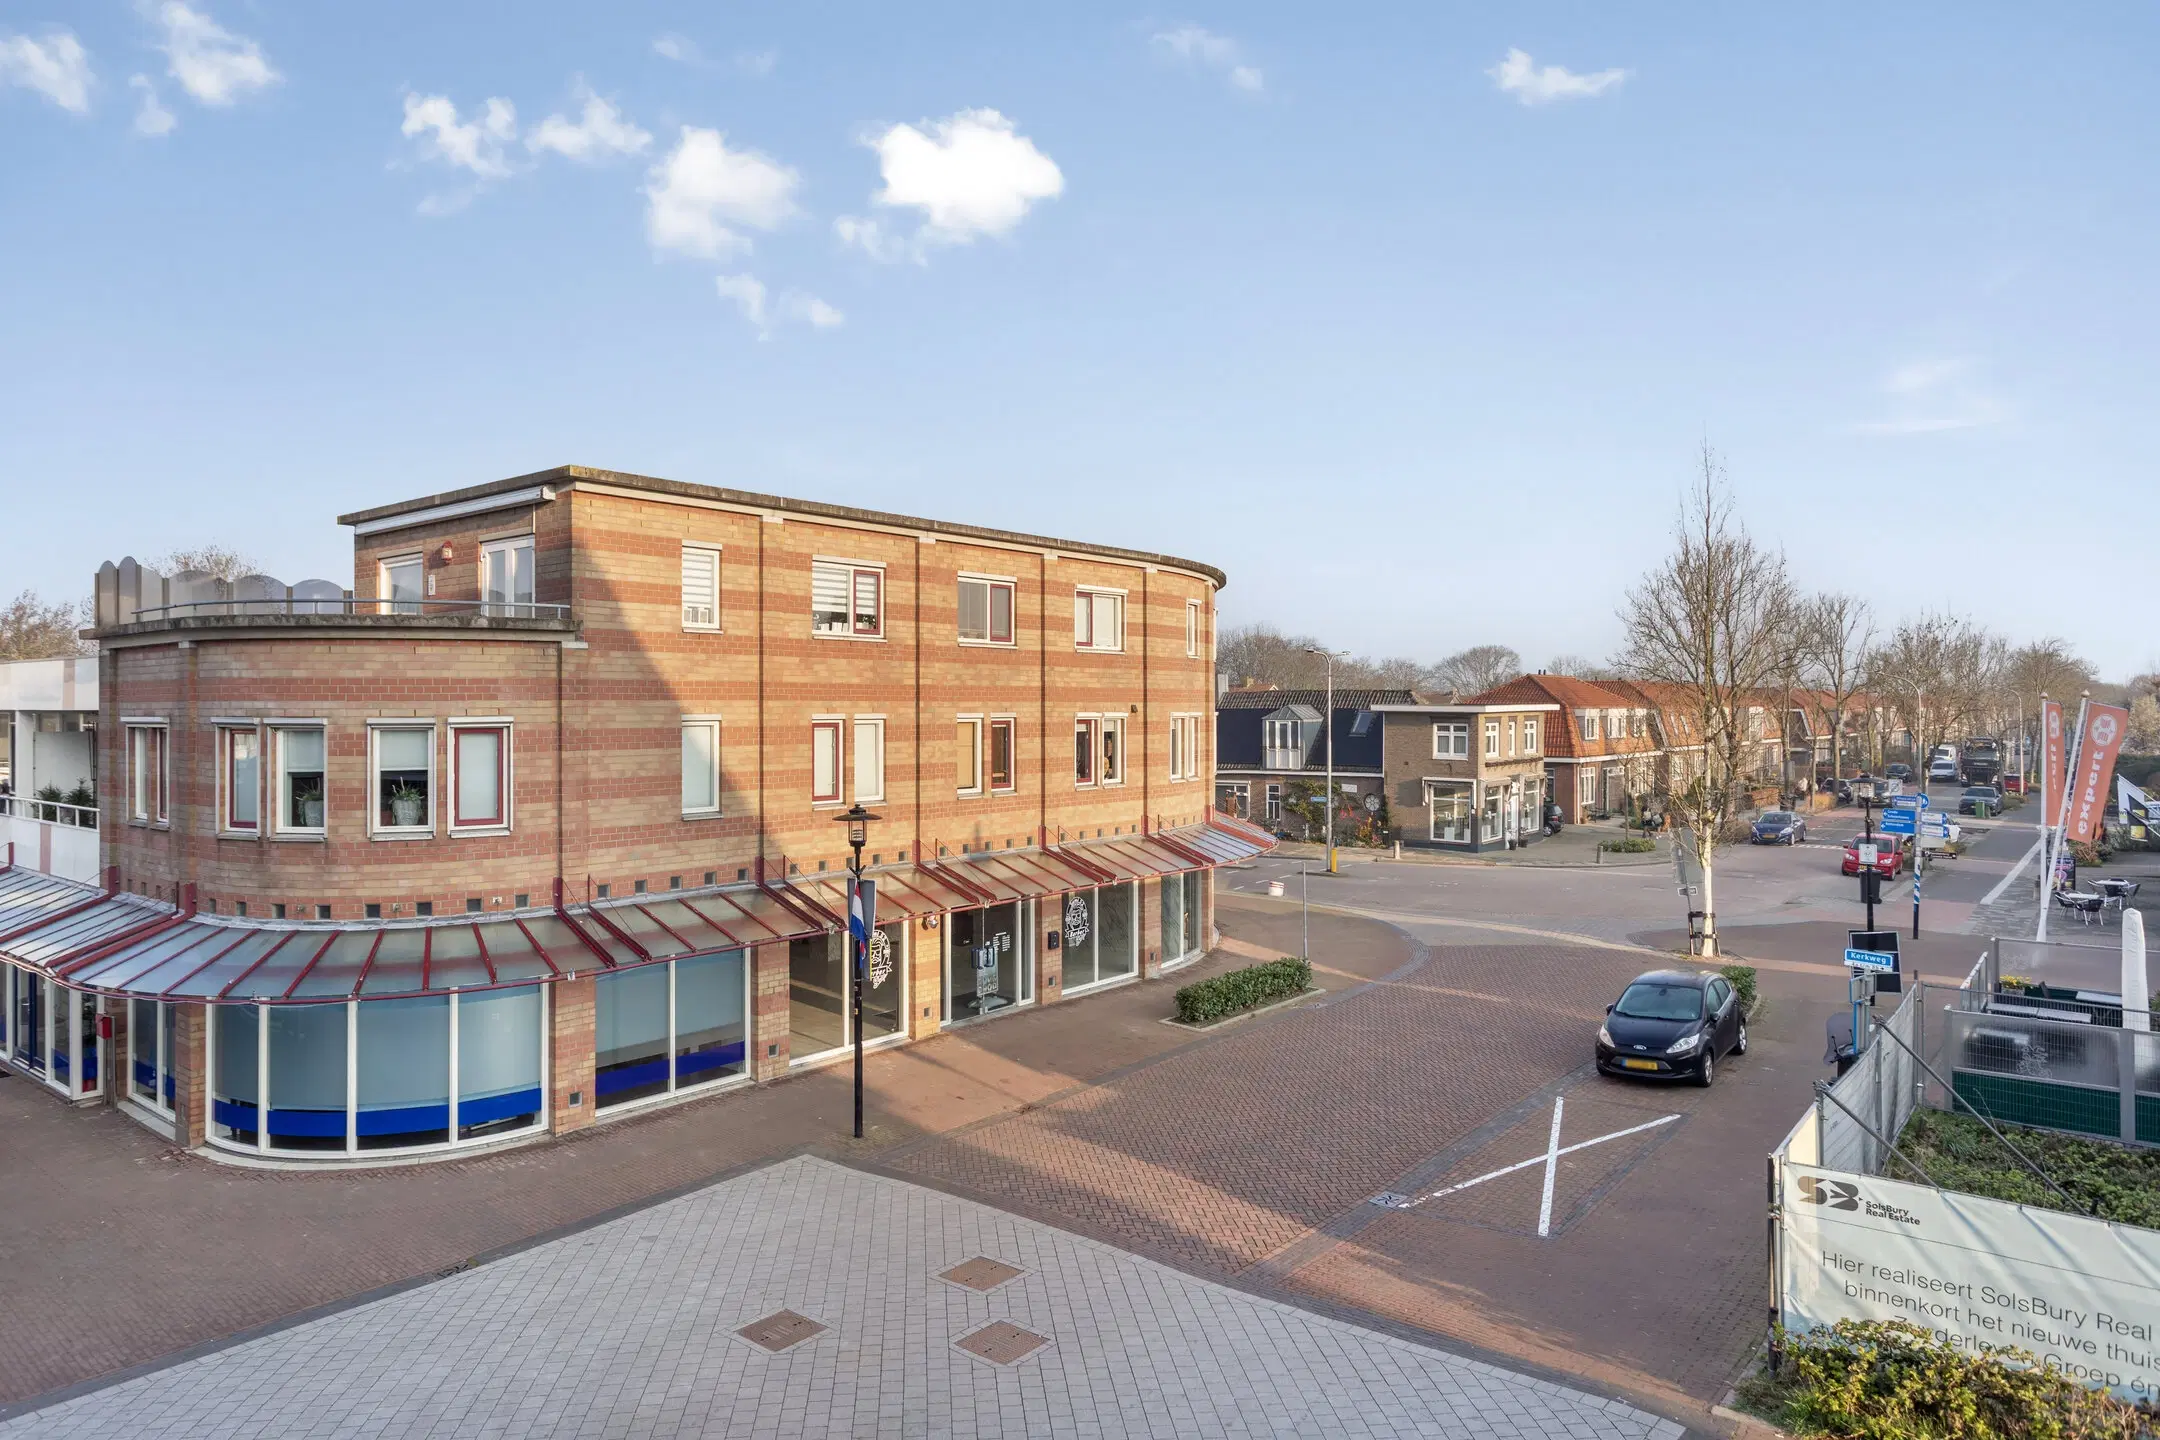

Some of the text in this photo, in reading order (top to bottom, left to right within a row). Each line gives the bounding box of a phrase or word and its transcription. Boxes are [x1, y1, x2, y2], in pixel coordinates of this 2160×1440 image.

[2078, 751, 2104, 835] expert
[1850, 951, 1887, 965] Kerkweg
[1865, 1200, 1910, 1216] SolsBury
[1865, 1208, 1921, 1226] Real Estate
[1822, 1250, 2152, 1342] Hier realiseert SolsBury Real
[1844, 1279, 1961, 1323] binnenkort
[1968, 1308, 2004, 1333] het
[2011, 1322, 2097, 1355] nieuwe
[2043, 1353, 2121, 1388] Groep
